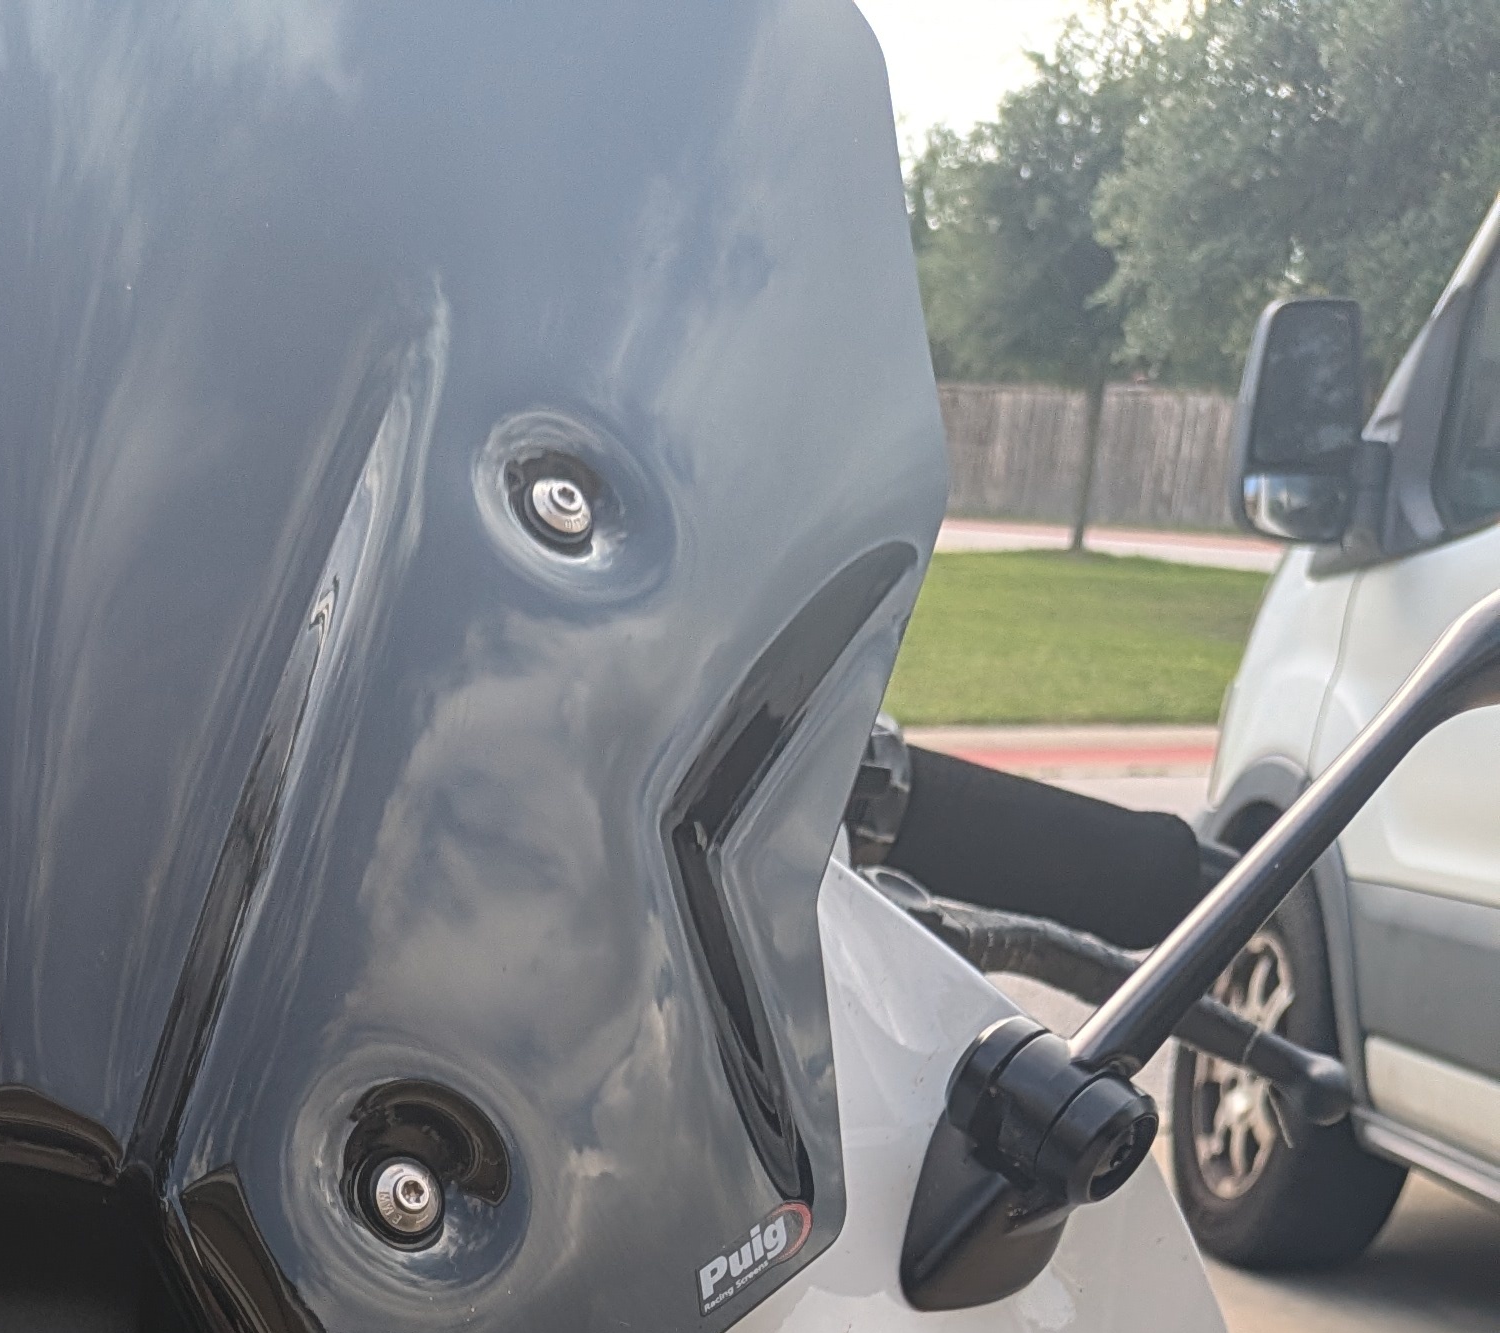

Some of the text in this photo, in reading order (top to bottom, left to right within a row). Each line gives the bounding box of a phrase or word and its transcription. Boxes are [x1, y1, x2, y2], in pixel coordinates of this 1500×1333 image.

[700, 1216, 787, 1300] Puig
[704, 1260, 769, 1312] Racing Screens
